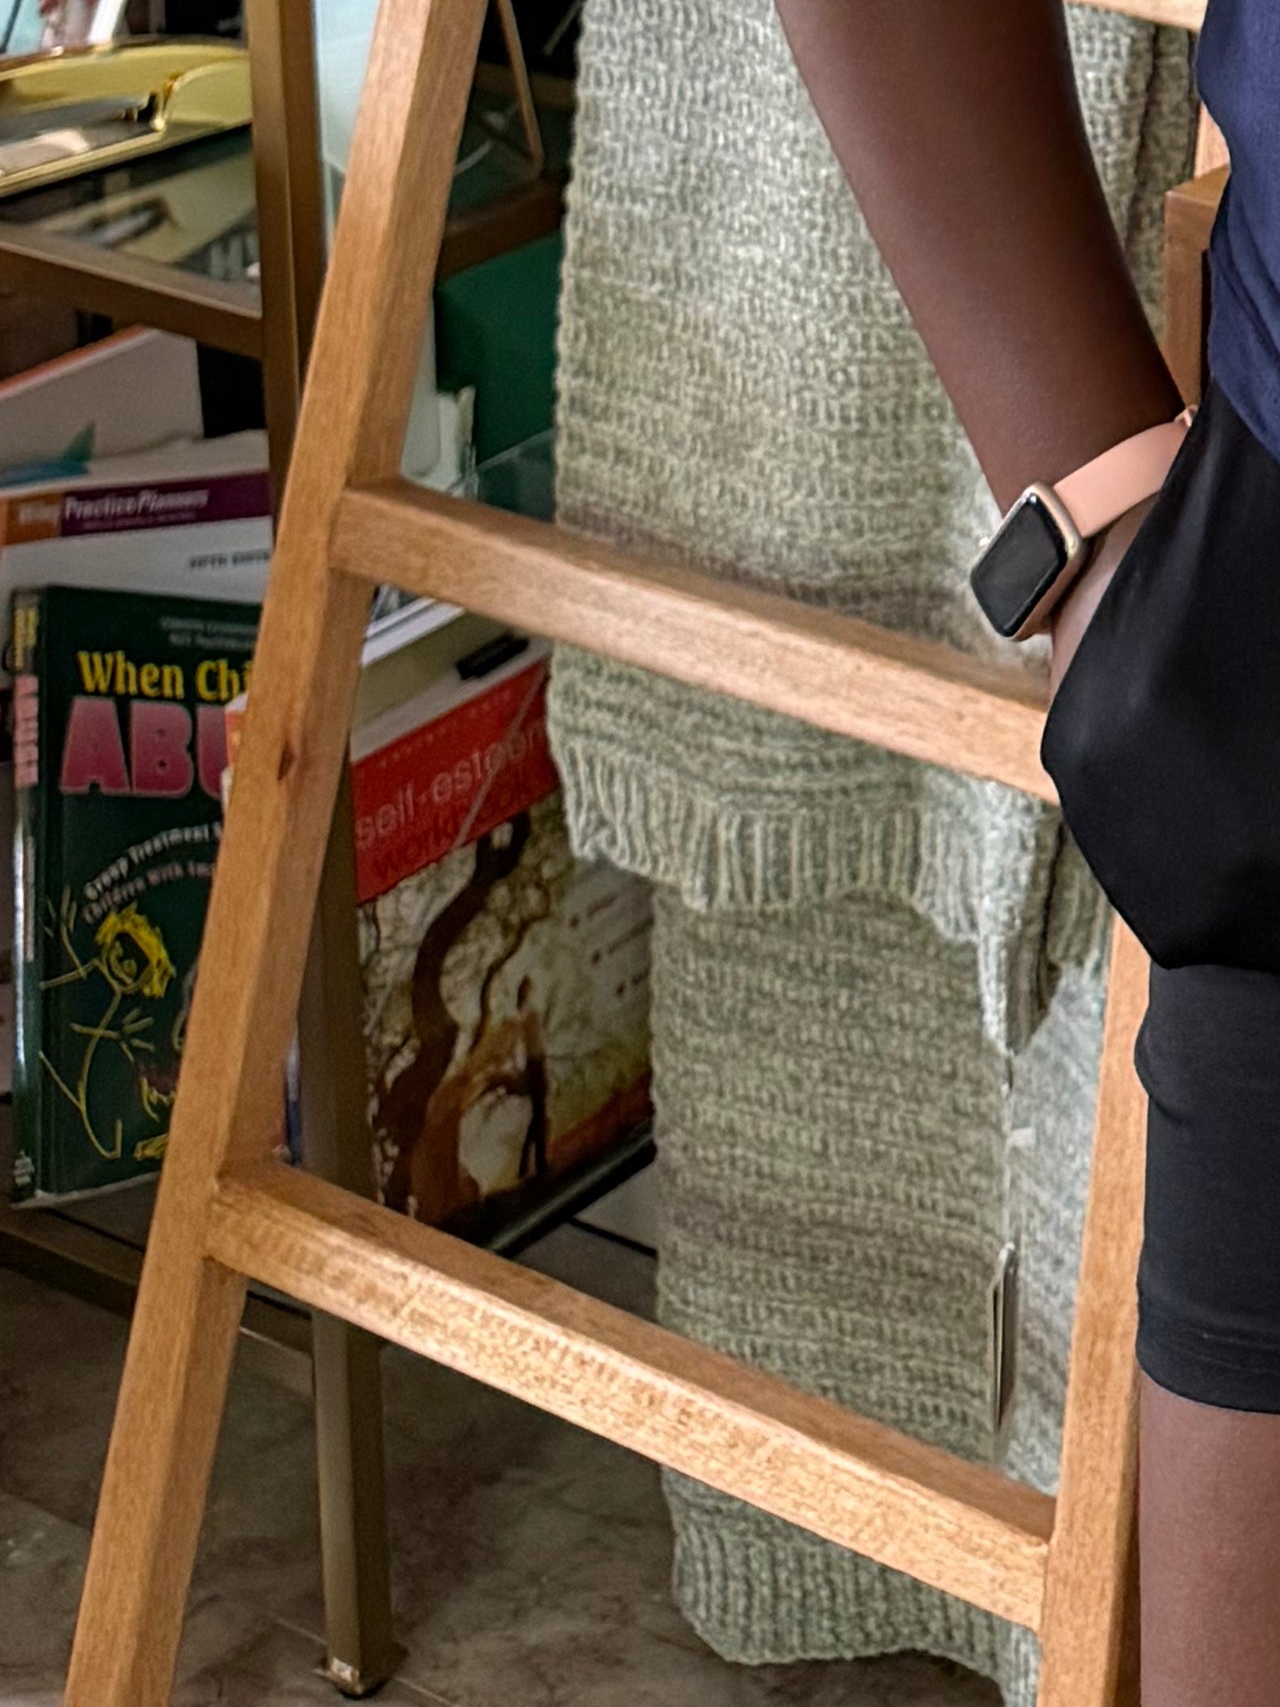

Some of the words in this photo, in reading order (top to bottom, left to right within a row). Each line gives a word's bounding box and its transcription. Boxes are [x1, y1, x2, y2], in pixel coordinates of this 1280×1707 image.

[77, 650, 184, 699] When
[74, 856, 129, 901] Group
[127, 822, 210, 866] Treatment
